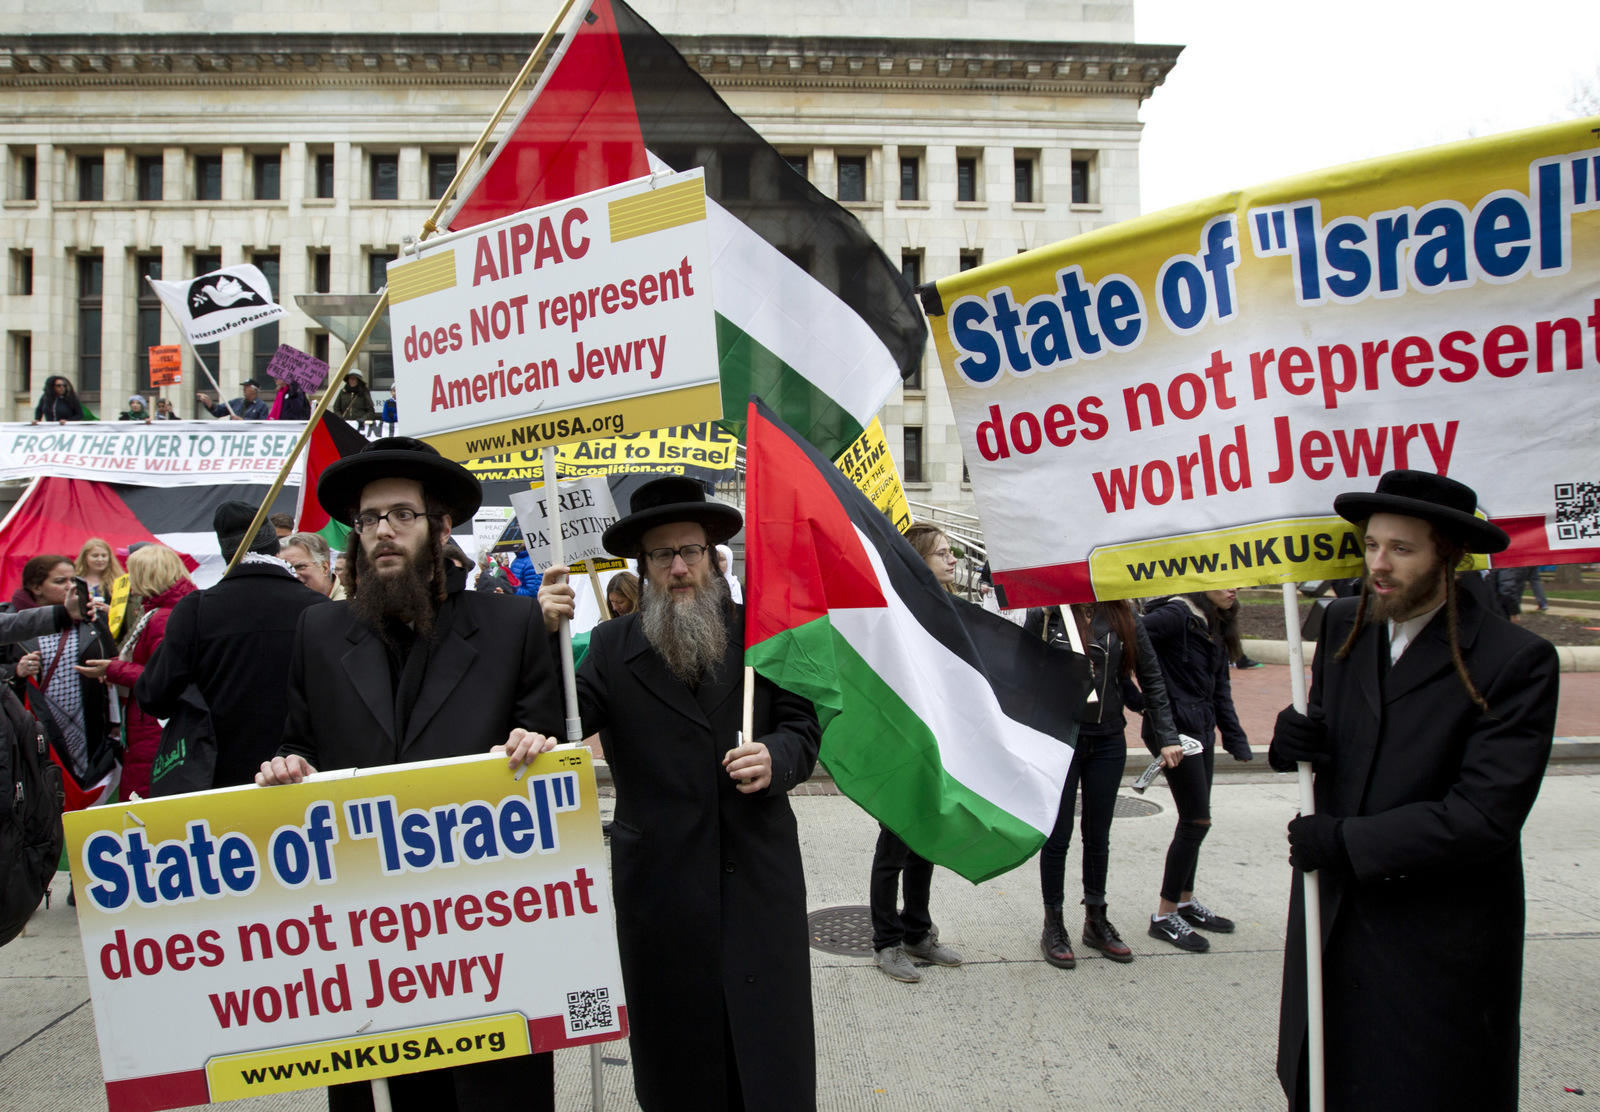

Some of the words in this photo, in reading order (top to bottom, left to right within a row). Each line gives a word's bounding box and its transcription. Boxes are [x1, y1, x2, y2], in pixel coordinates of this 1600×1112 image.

[472, 207, 591, 287] AIPAC
[404, 322, 463, 363] does
[469, 294, 529, 347] NOT
[538, 255, 694, 333] represent
[952, 263, 1142, 383] State
[1161, 219, 1238, 330] of
[430, 356, 560, 413] American
[567, 334, 667, 384] Jewry
[975, 396, 1110, 464] does
[1123, 348, 1237, 433] not
[1248, 297, 1600, 410] represent
[11, 434, 76, 454] FROM
[79, 435, 120, 456] THE
[120, 434, 182, 457] RIVER
[188, 435, 216, 457] TO
[220, 435, 258, 457] THE
[260, 434, 299, 457] SEA
[23, 453, 138, 470] PALESTINE
[144, 458, 192, 471] WILL
[198, 458, 224, 471] BE
[228, 458, 285, 471] FREE!
[466, 411, 624, 455] www.NKUSA.org
[573, 442, 617, 460] Aid
[625, 443, 651, 459] to
[659, 442, 730, 465] Israel
[1092, 424, 1252, 514] world
[1266, 414, 1460, 484] Jewry
[870, 474, 894, 503] RETURN
[871, 464, 886, 481] THE
[1126, 532, 1364, 582] www.NKUSA
[86, 824, 257, 910] State
[272, 804, 335, 887] of
[348, 775, 578, 872] "Israel"
[99, 929, 225, 981] does
[238, 904, 337, 962] not
[349, 868, 598, 951] represent
[208, 963, 352, 1030] world
[364, 952, 505, 1009] Jewry
[240, 1029, 507, 1085] www.NKUSA.org
